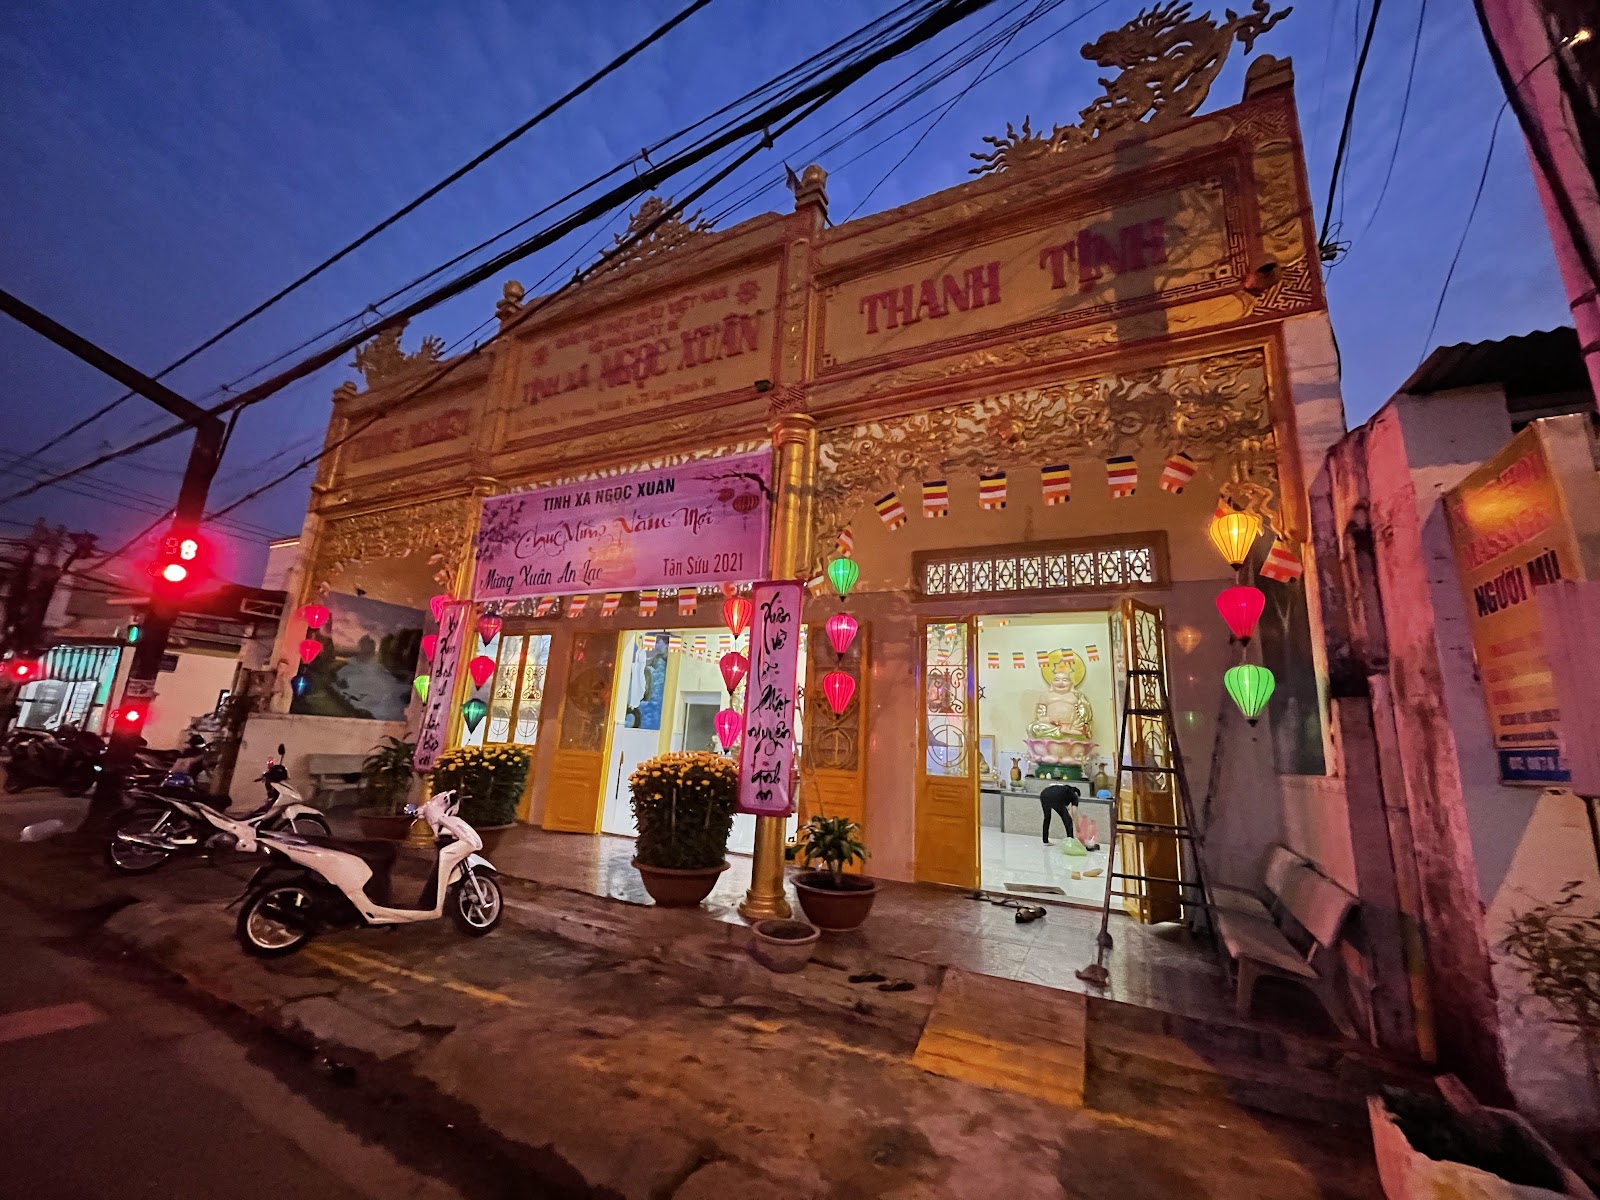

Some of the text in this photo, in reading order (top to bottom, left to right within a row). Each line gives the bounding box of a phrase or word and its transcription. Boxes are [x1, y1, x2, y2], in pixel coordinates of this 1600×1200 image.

[858, 217, 1169, 335] THANH TỊNH
[595, 485, 633, 504] NGỌC
[637, 476, 675, 497] XUÂN
[613, 508, 671, 546] Năm
[519, 564, 552, 587] Xuân
[557, 560, 577, 584] An
[663, 558, 683, 576] Tân
[713, 552, 743, 573] 2021
[1473, 565, 1527, 617] NGƯỜI
